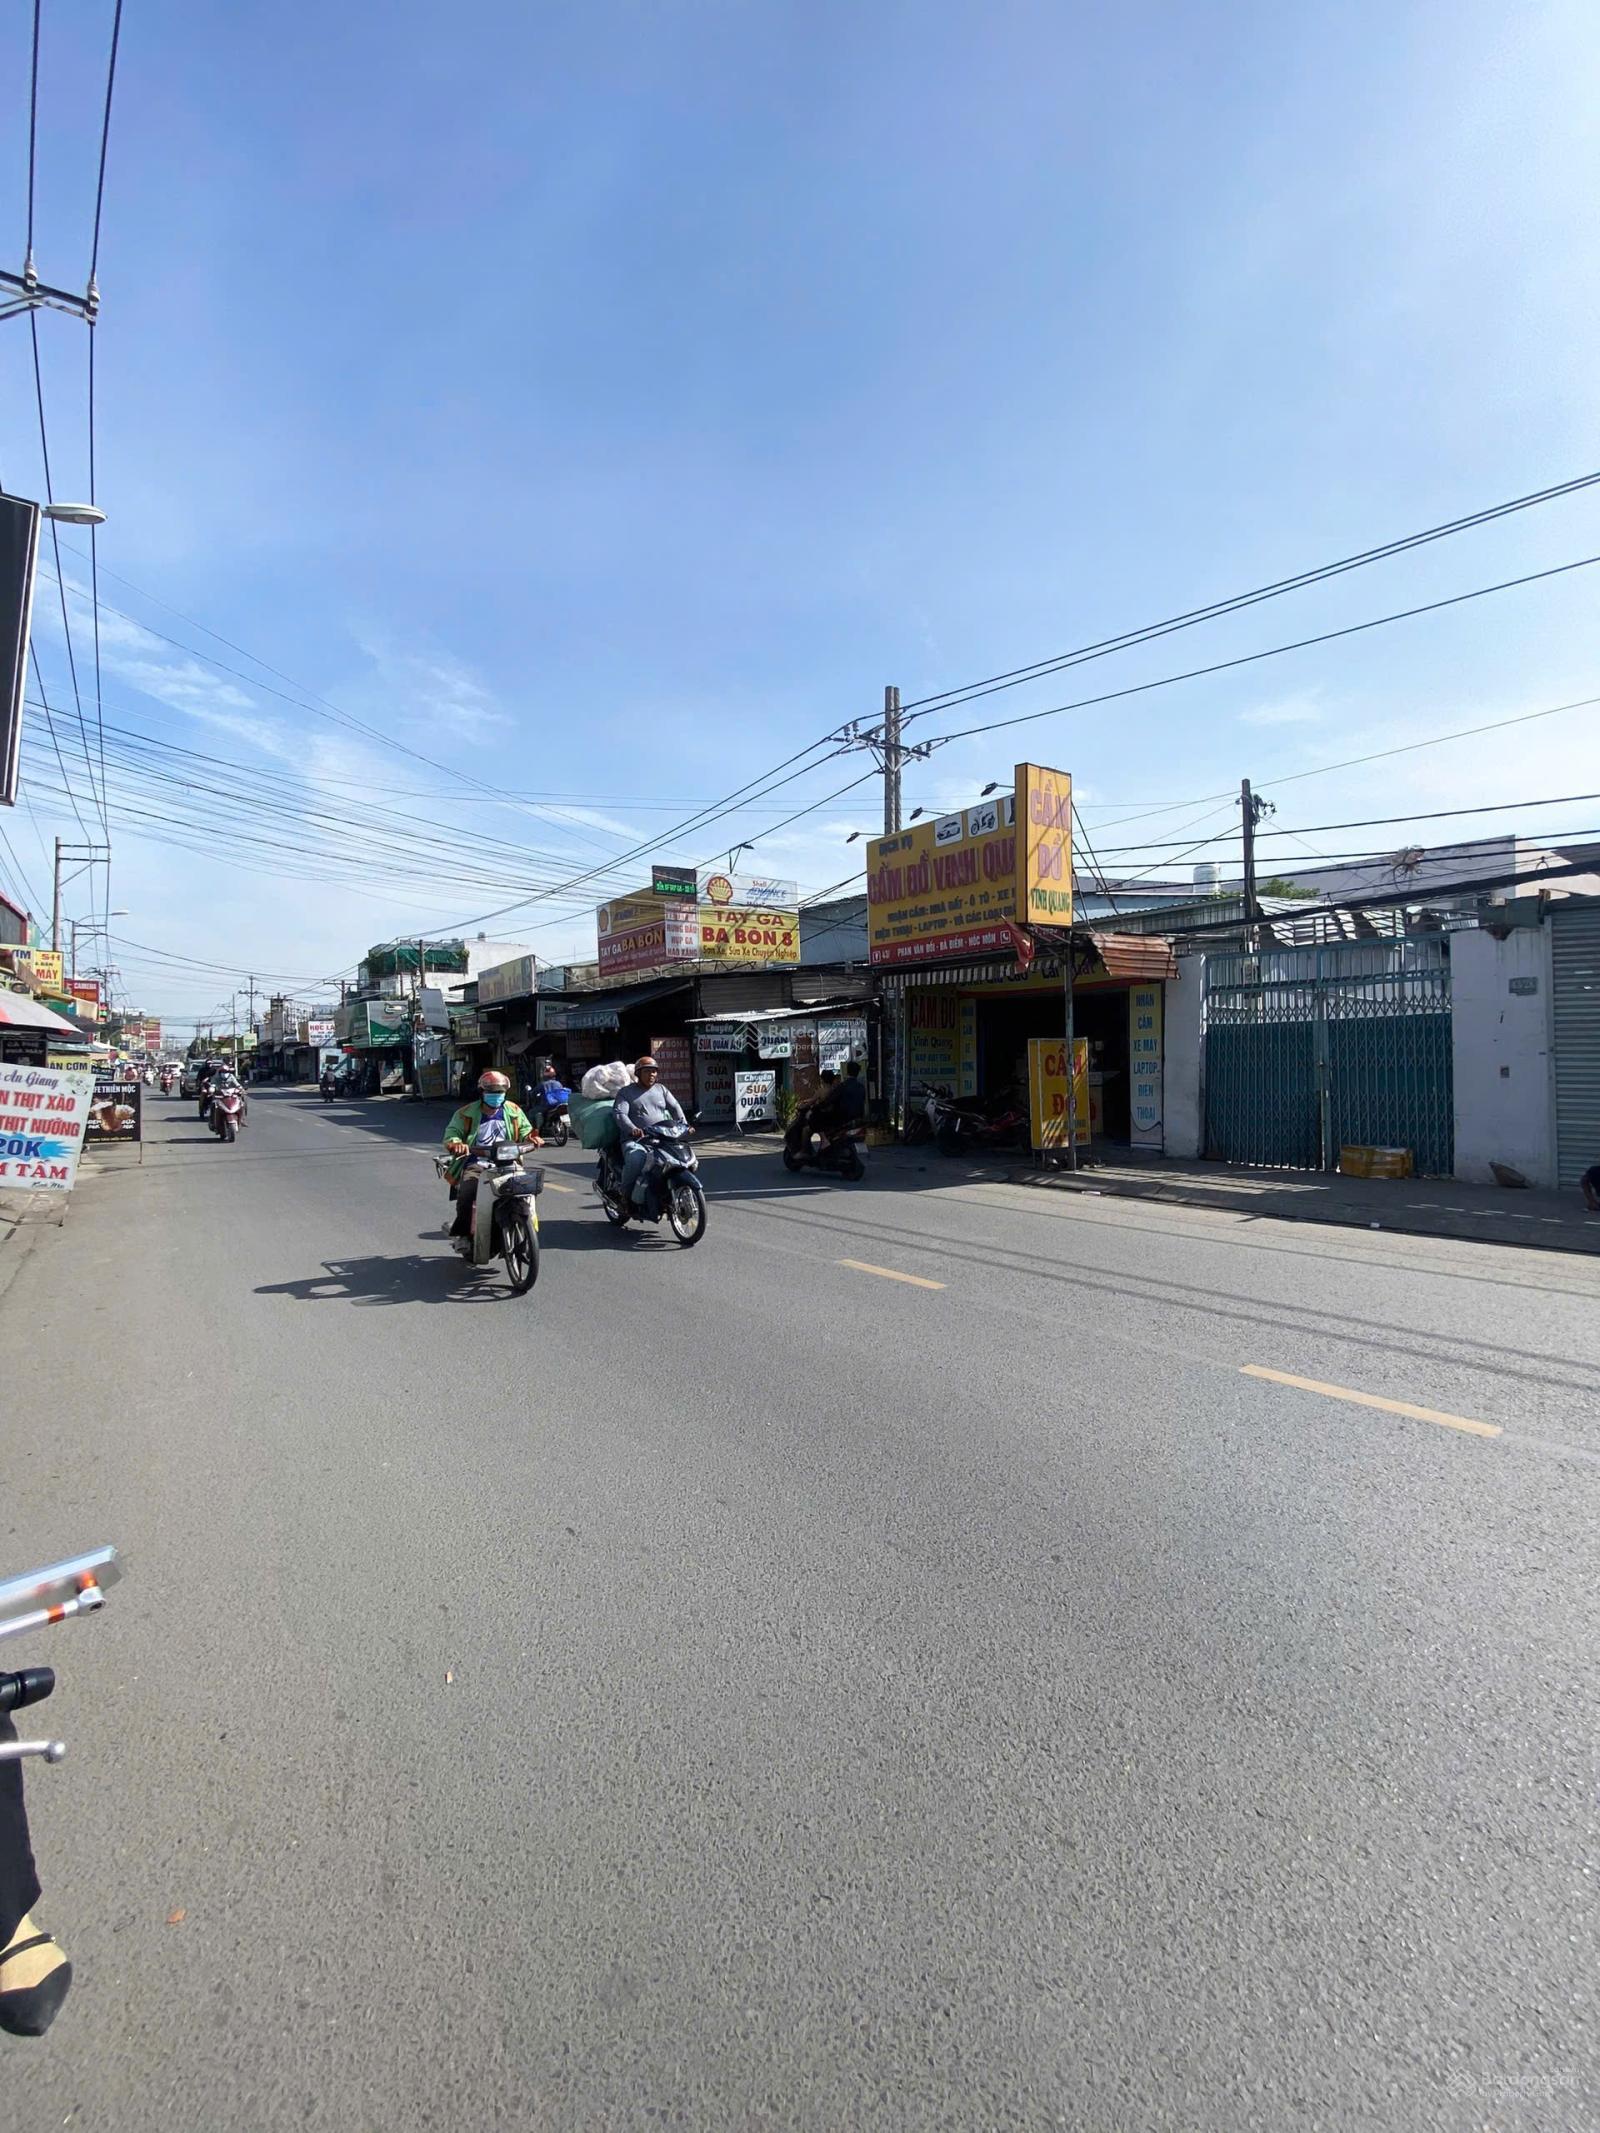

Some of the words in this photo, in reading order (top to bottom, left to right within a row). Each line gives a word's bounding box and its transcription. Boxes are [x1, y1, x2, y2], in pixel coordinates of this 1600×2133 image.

[746, 887, 787, 898] ADVANCE
[997, 888, 1009, 901] XE
[1047, 890, 1070, 916] QUANG
[715, 911, 748, 923] TAY
[757, 914, 784, 926] GA
[918, 917, 947, 932] LAPTOP
[702, 926, 730, 943] BA
[782, 932, 793, 946] 8
[601, 946, 611, 957] TAY
[612, 943, 621, 954] GA
[622, 937, 637, 952] BA
[897, 945, 912, 957] PHAN
[1133, 1039, 1142, 1052] XE
[1133, 1061, 1158, 1075] LAPTOP
[4, 1072, 22, 1084] An
[26, 1072, 59, 1089] Giang
[14, 1091, 44, 1111] THỊT
[31, 1116, 80, 1137] NƯỚNG
[16, 1159, 69, 1179] TẤM
